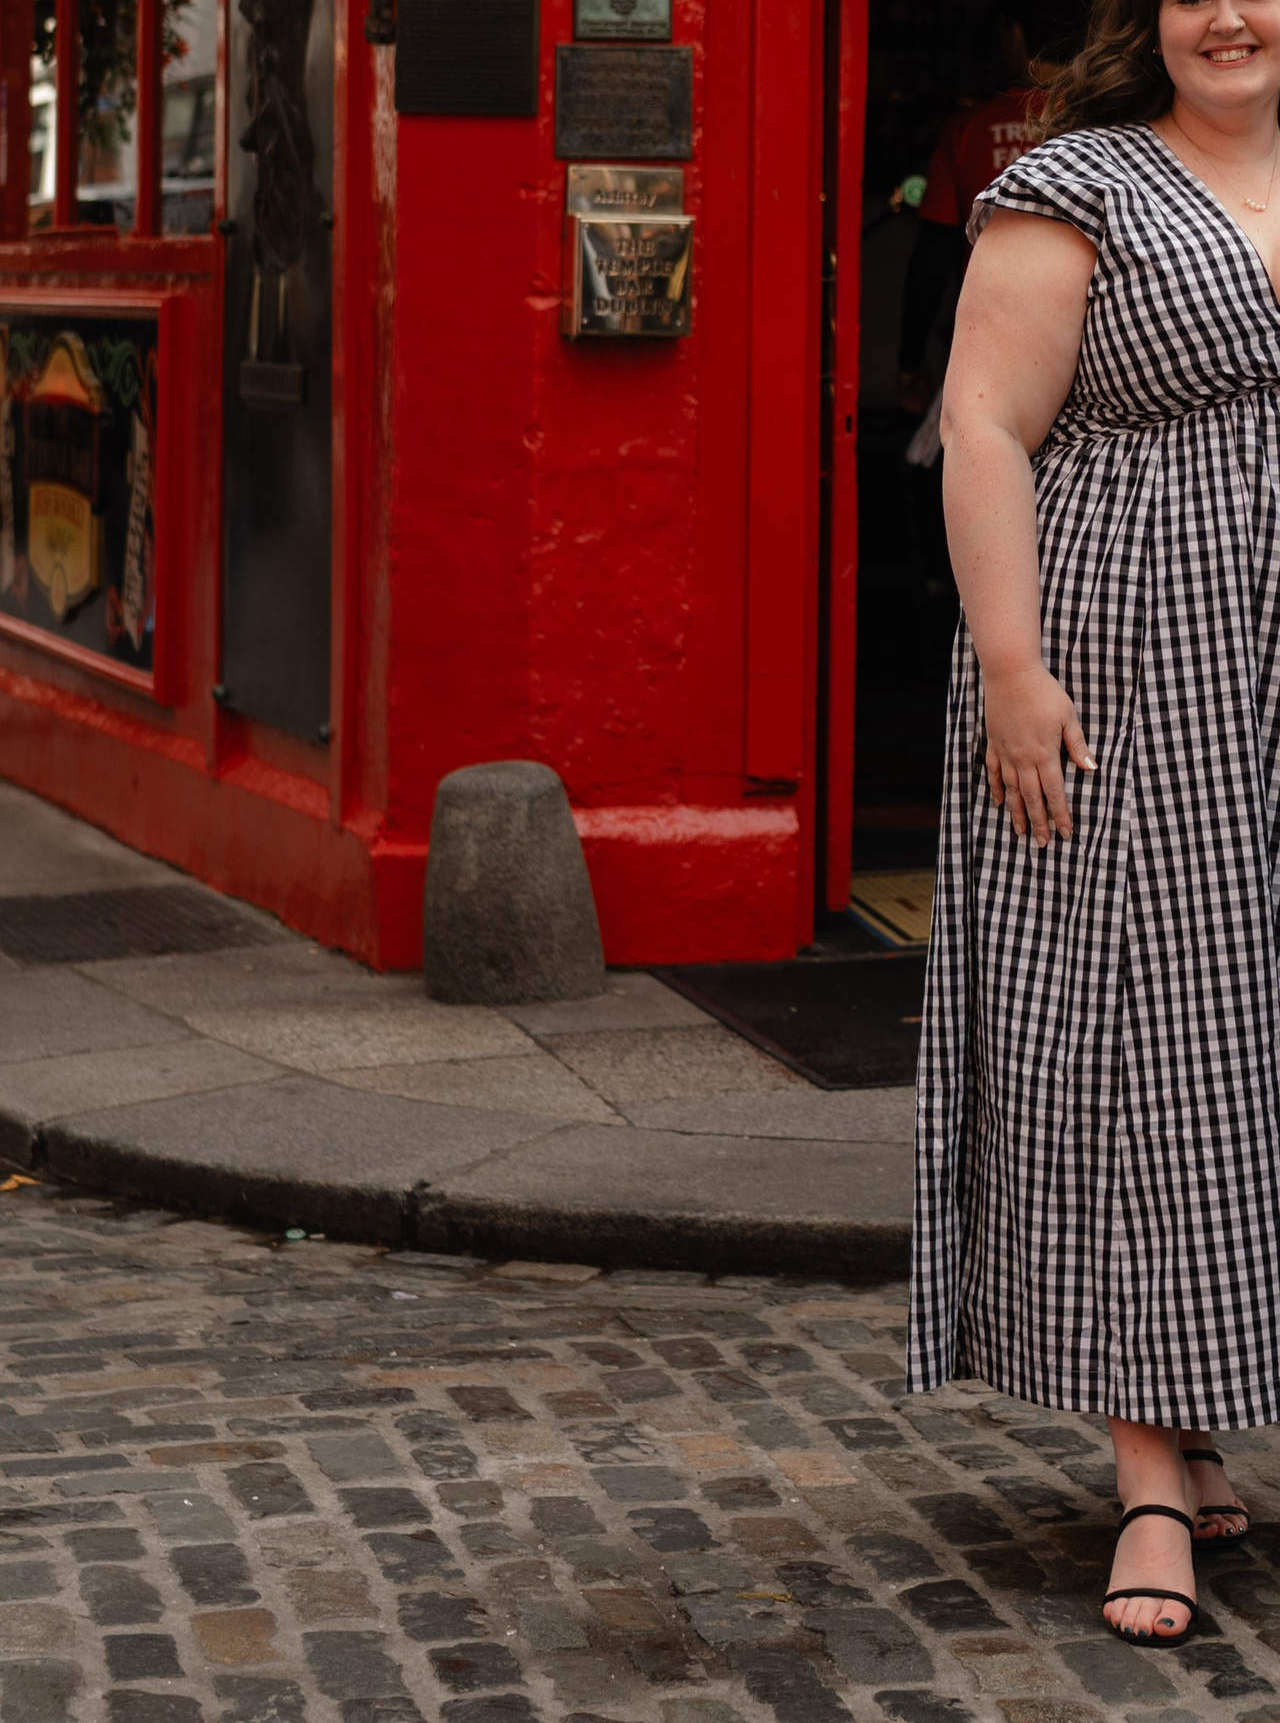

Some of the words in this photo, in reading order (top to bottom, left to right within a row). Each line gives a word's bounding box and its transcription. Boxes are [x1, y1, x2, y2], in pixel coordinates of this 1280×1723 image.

[592, 189, 658, 208] Ashtray
[616, 238, 656, 258] THE
[595, 257, 674, 277] TEMPLE
